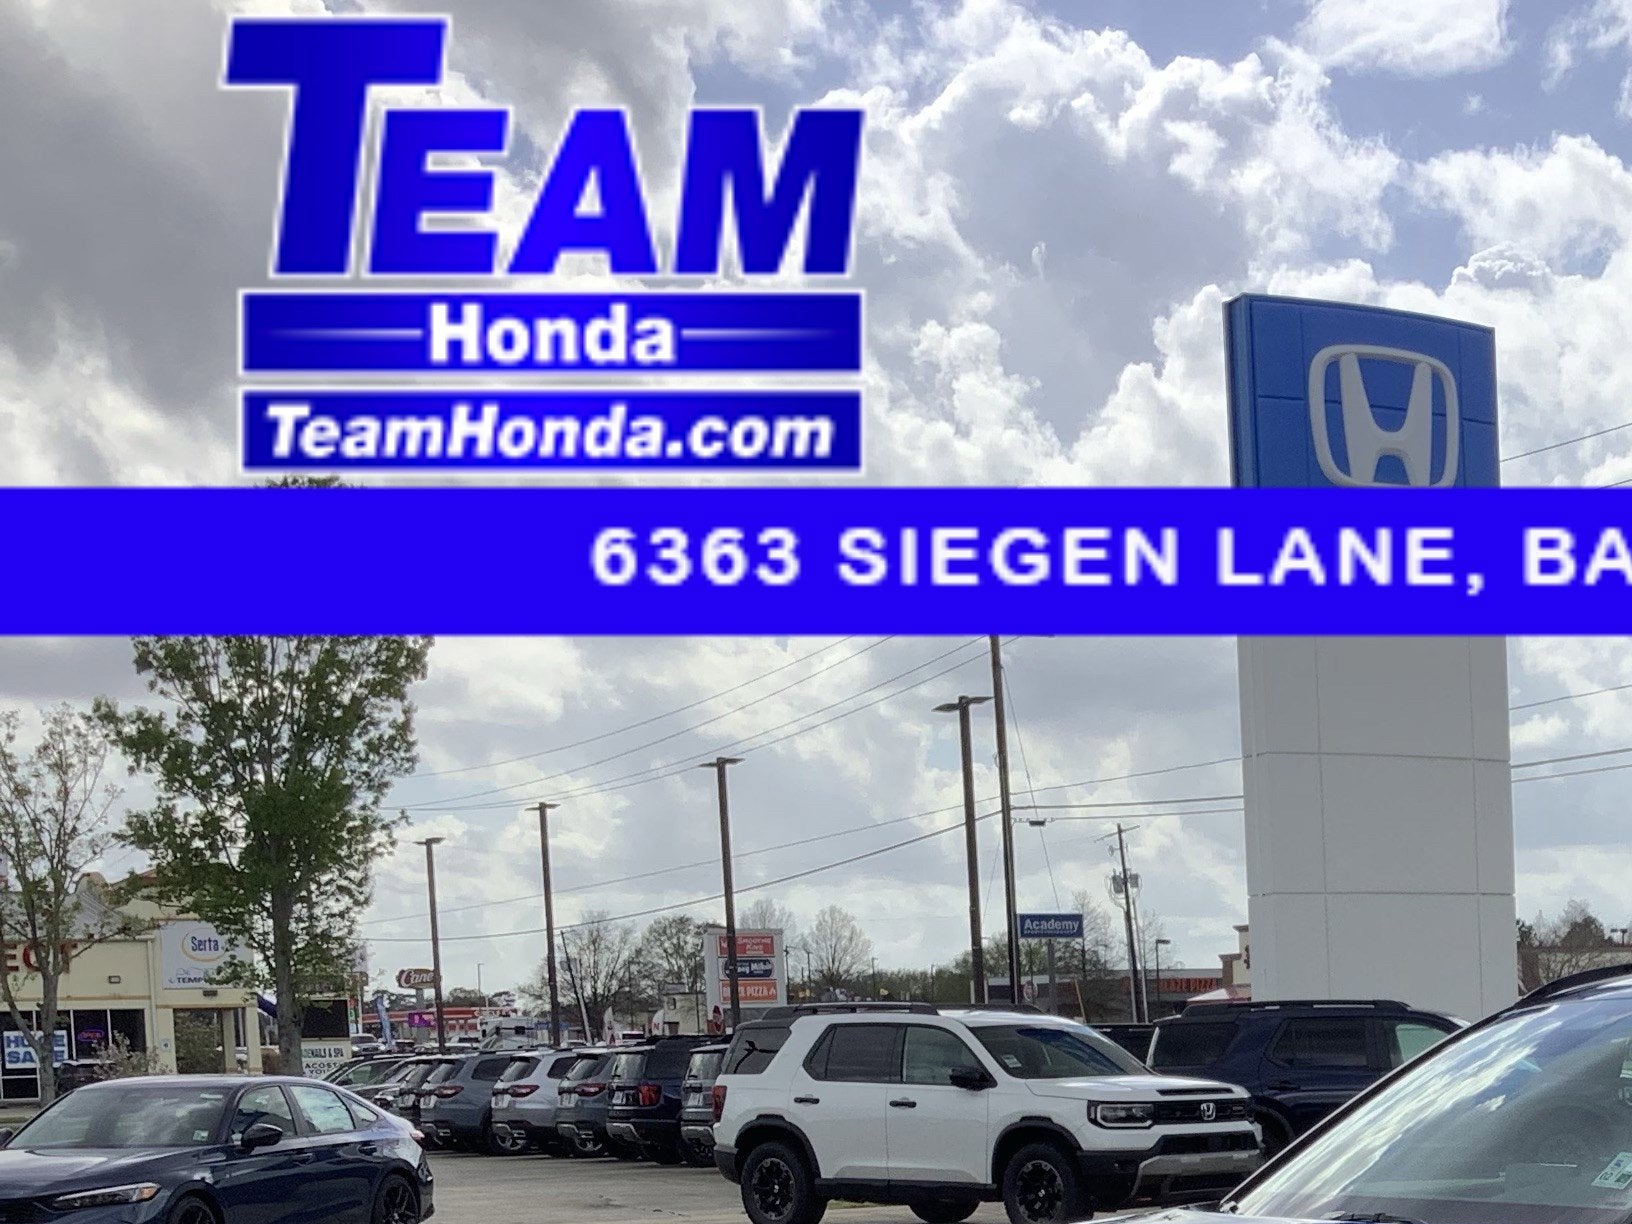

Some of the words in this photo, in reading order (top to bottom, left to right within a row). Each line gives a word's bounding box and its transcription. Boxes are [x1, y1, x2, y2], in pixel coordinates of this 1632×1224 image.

[1023, 918, 1080, 932] Academy
[191, 936, 219, 952] Serta
[6, 1050, 66, 1064] SAE
